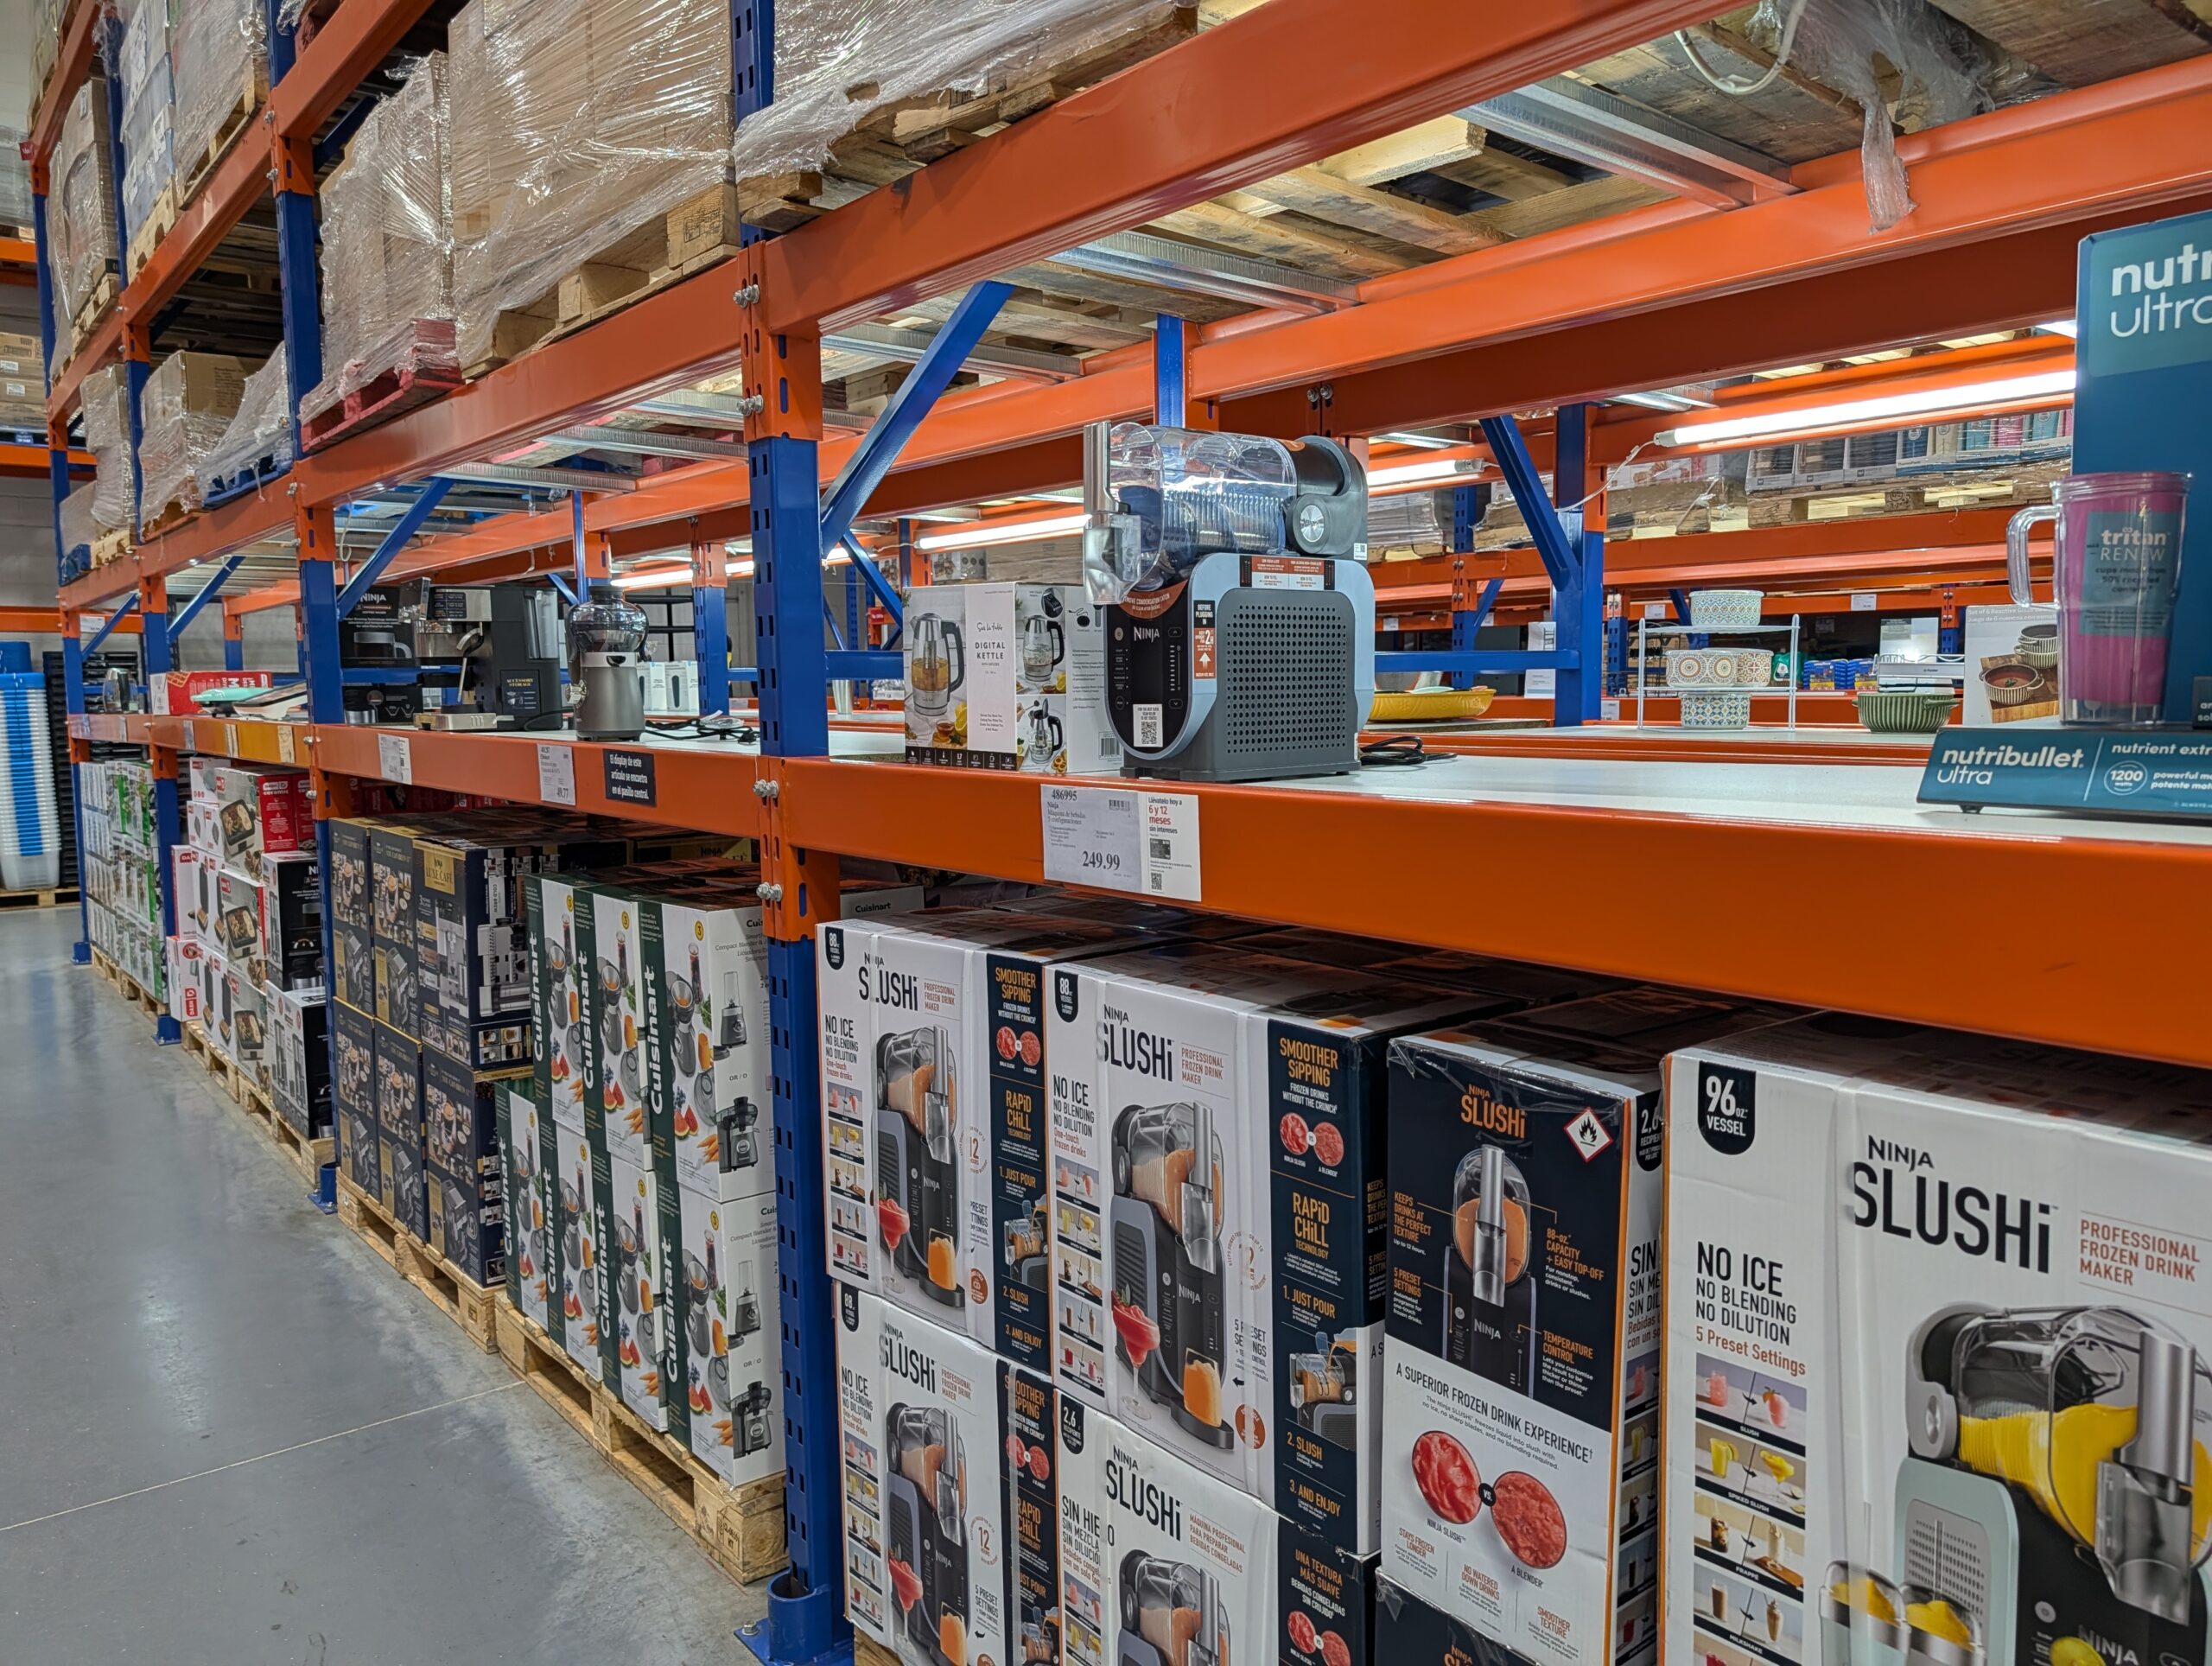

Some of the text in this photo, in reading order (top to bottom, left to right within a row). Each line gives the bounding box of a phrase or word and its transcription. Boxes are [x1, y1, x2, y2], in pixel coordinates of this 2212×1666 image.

[360, 594, 386, 604] NINJA
[1134, 626, 1160, 643] NINJA
[1942, 746, 2083, 768] nutribullet
[2112, 743, 2176, 754] nutrient
[1937, 766, 1993, 785] ultra
[2110, 770, 2143, 781] 1200
[1052, 789, 1077, 801] 486995
[1148, 796, 1168, 805] Llévatelo
[1148, 805, 1167, 816] 6 y 12
[1149, 817, 1171, 825] meses
[1082, 850, 1120, 871] 249.99
[855, 902, 891, 912] Cuisinart
[531, 931, 543, 1062] Cuisinart
[578, 950, 594, 1089] Cuisinart
[825, 1014, 854, 1039] NO ICE
[1103, 1004, 1129, 1026] NINJA
[644, 963, 663, 1115] Cuisinart
[1181, 1047, 1224, 1069] PROFESSIONAL
[1280, 1037, 1338, 1070] SMOOTHER
[1181, 1062, 1223, 1079] FROZEN DRINK
[1182, 1073, 1202, 1085] MAKER
[1288, 1059, 1331, 1087] SiPPING
[1053, 1074, 1089, 1106] NO ICE
[1469, 1084, 1491, 1099] NINJA
[1706, 1075, 1736, 1117] 96
[1053, 1099, 1095, 1123] NO BLENDING
[1460, 1094, 1525, 1139] SLUSHi
[1053, 1113, 1092, 1138] NO DILUTION
[1707, 1115, 1746, 1136] VESSEL
[1867, 1135, 1935, 1173] NINJA
[499, 1135, 513, 1256] Cuisinart
[1394, 1191, 1414, 1206] KEEPS
[1394, 1203, 1424, 1223] DRINKS AT
[1394, 1213, 1431, 1236] THE PERFECT
[1845, 1161, 2050, 1275] SLUSHi
[543, 1166, 556, 1294] Cuisinart
[1394, 1224, 1419, 1243] TEXTURE
[2080, 1218, 2201, 1263] PROFESSIONAL
[1295, 1239, 1329, 1260] TECHNOLOGY
[1547, 1240, 1580, 1260] CAPACITY
[2080, 1238, 2196, 1282] FROZEN DRINK
[595, 1201, 610, 1339] Cuisinart
[1394, 1267, 1421, 1285] 5 PRESET
[1554, 1256, 1573, 1271] EASY
[1574, 1262, 1605, 1281] TOP-OFF
[1697, 1241, 1783, 1297] NO ICE
[2079, 1257, 2134, 1287] MAKER
[1394, 1277, 1421, 1296] SETTINGS
[663, 1235, 678, 1383] Cuisinart
[1283, 1285, 1335, 1319] 1. JUST POUR
[1696, 1277, 1797, 1325] NO BLENDING
[1696, 1299, 1790, 1346] NO DILUTION
[1543, 1330, 1593, 1359] TEMPERATURE
[1543, 1343, 1574, 1364] CONTROL
[1696, 1325, 1806, 1377] 5 Preset Settings
[1396, 1363, 1402, 1377] A
[1405, 1366, 1449, 1399] SUPERIOR
[1452, 1387, 1488, 1417] FROZEN
[1491, 1402, 1522, 1433] DRINK
[1740, 1426, 1759, 1437] SLUSH
[1113, 1444, 1139, 1471] NINJA
[1289, 1479, 1341, 1517] 3. AND ENJOY
[1728, 1491, 1770, 1512] SPIKED SLUSH
